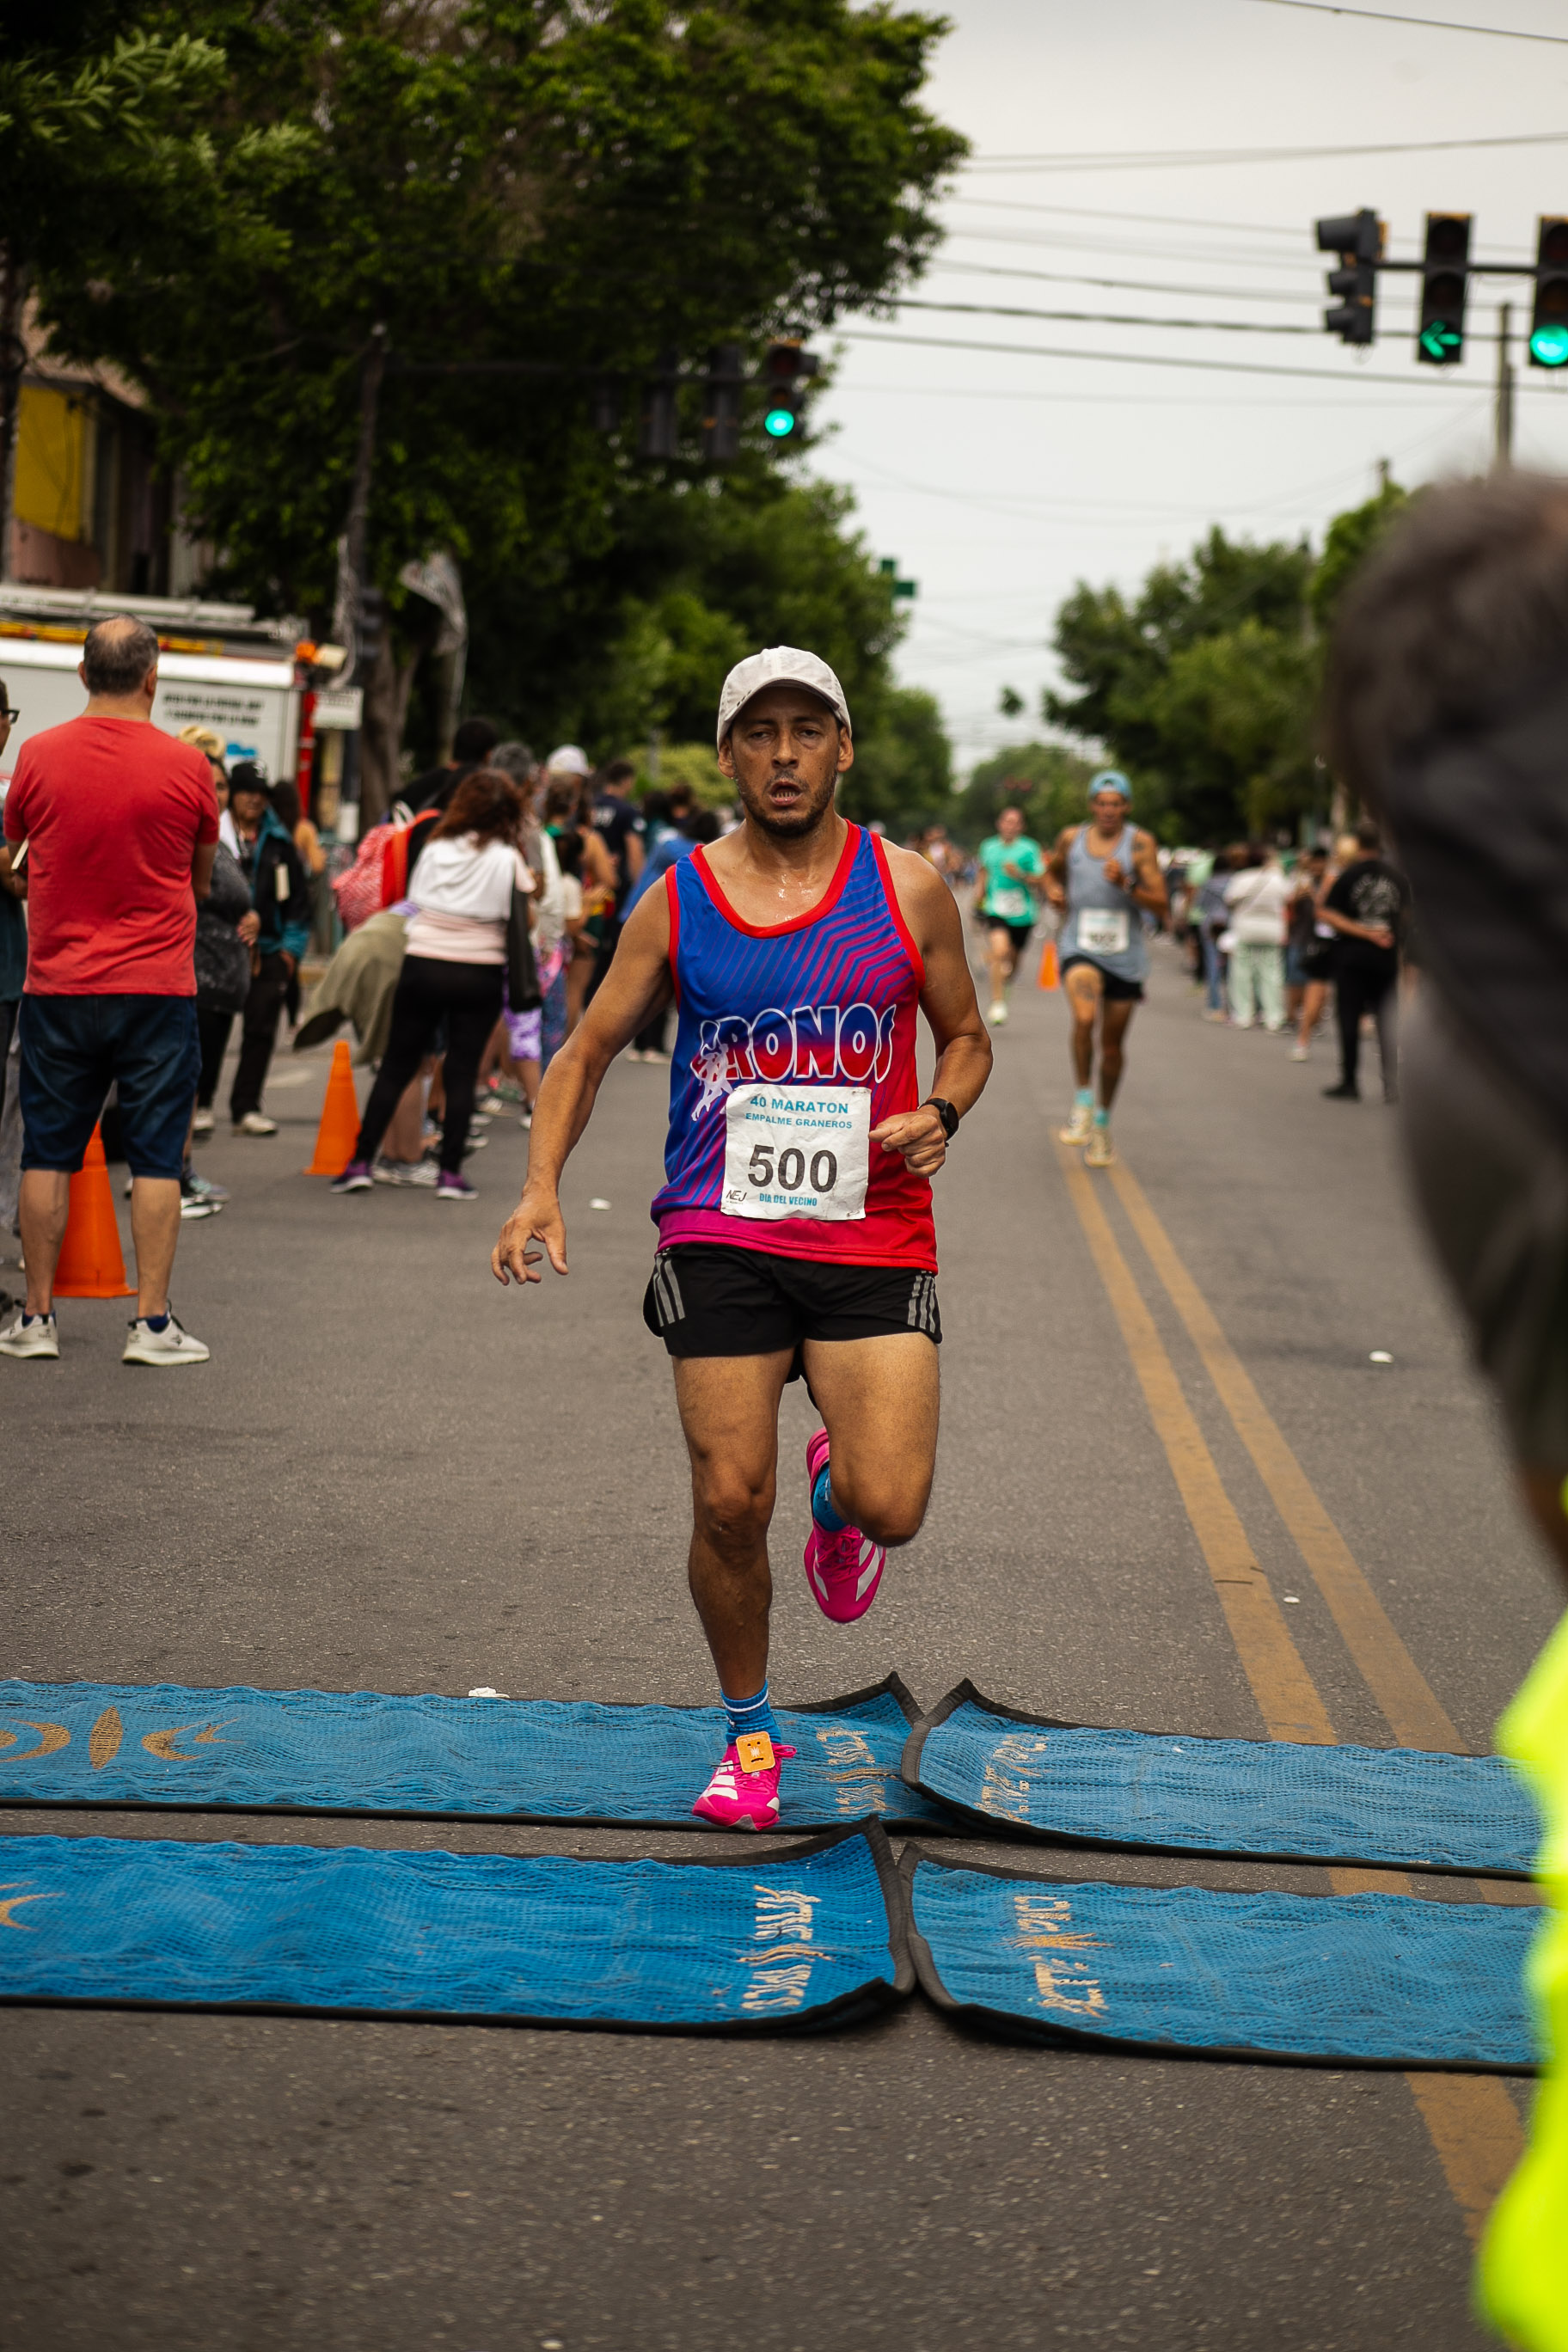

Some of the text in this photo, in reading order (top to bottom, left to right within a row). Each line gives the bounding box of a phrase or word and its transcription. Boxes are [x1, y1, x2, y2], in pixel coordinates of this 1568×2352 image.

[750, 1095, 849, 1114] 40 MARATON
[745, 1112, 853, 1130] EMPALME GRANEROS
[748, 1144, 837, 1193] 500
[759, 1192, 818, 1207] DIA DEL VECINO
